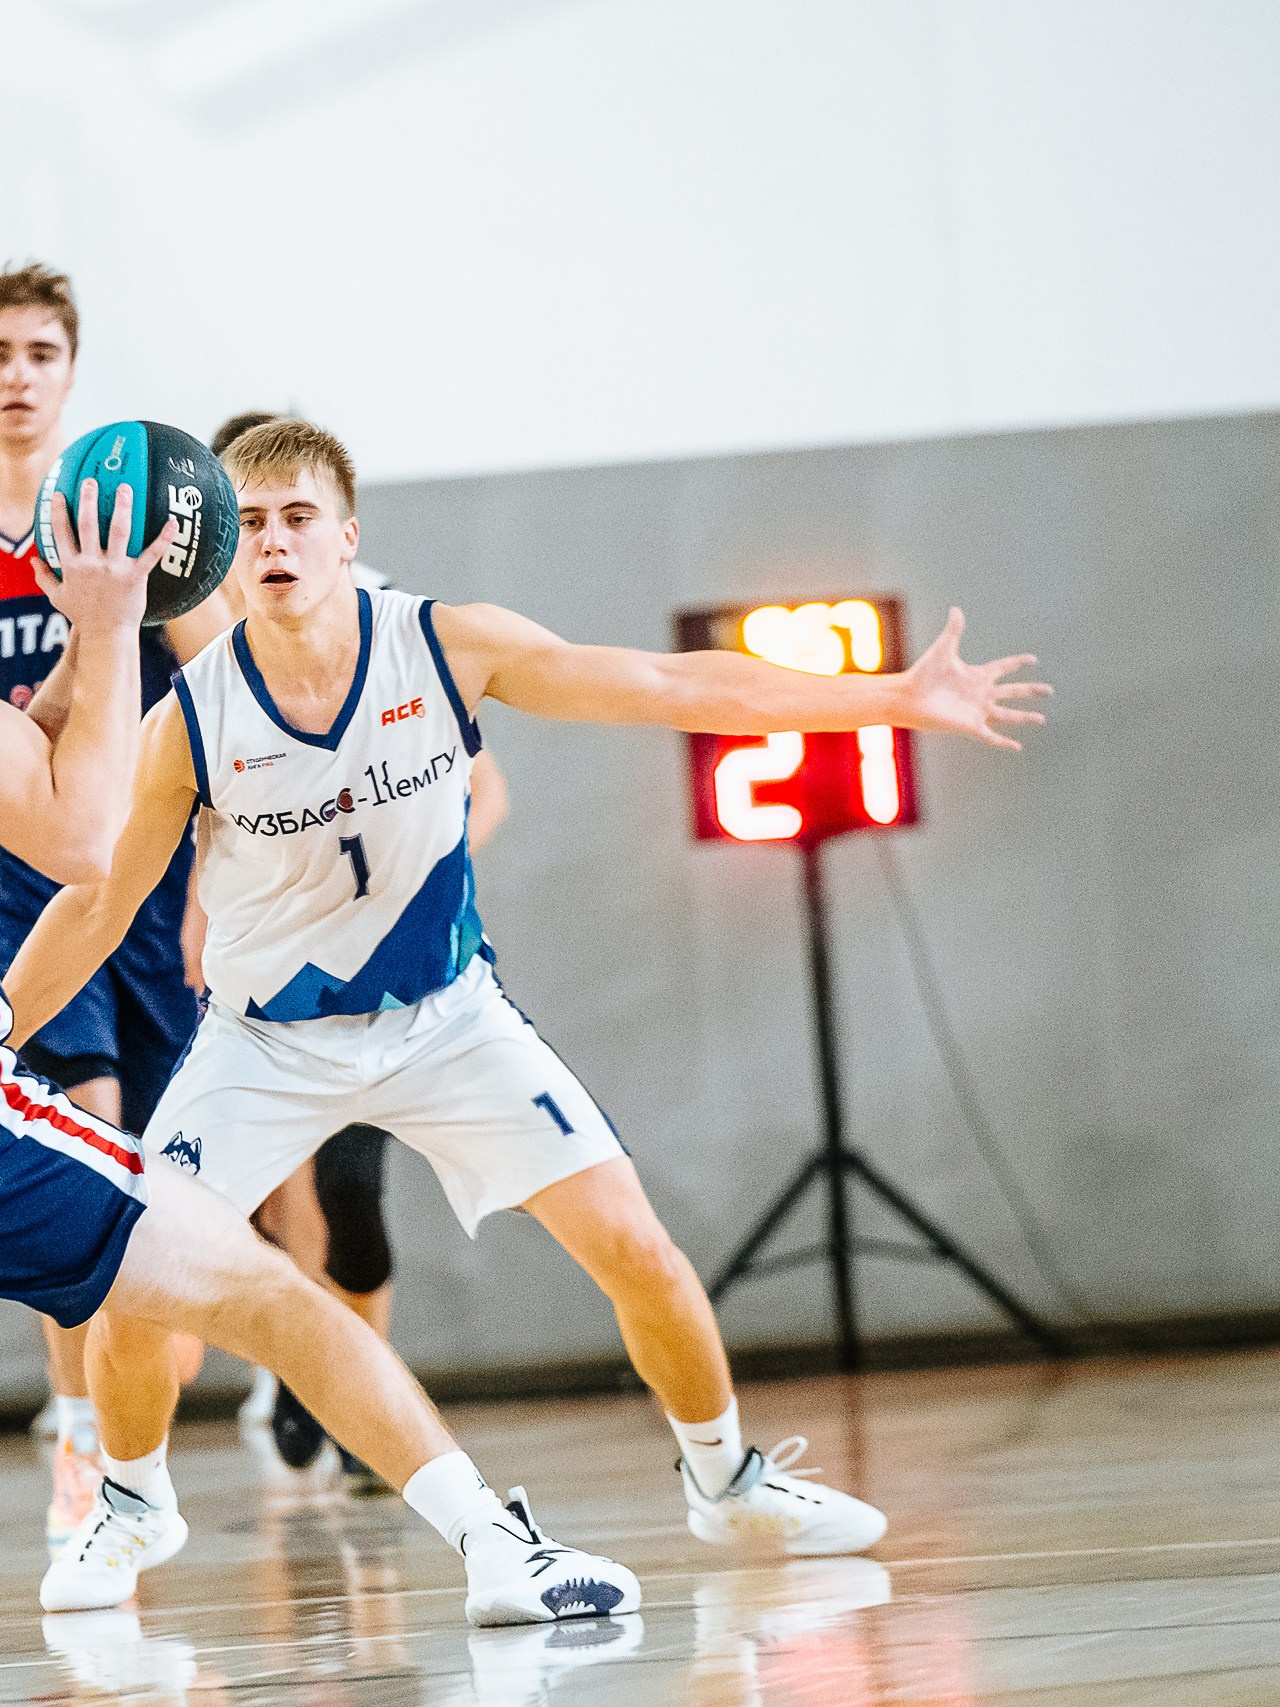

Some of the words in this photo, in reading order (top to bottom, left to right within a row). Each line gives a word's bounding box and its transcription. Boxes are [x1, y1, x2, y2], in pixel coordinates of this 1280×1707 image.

[381, 696, 426, 727] АСБ
[338, 832, 371, 902] 1
[530, 1090, 574, 1137] 1
